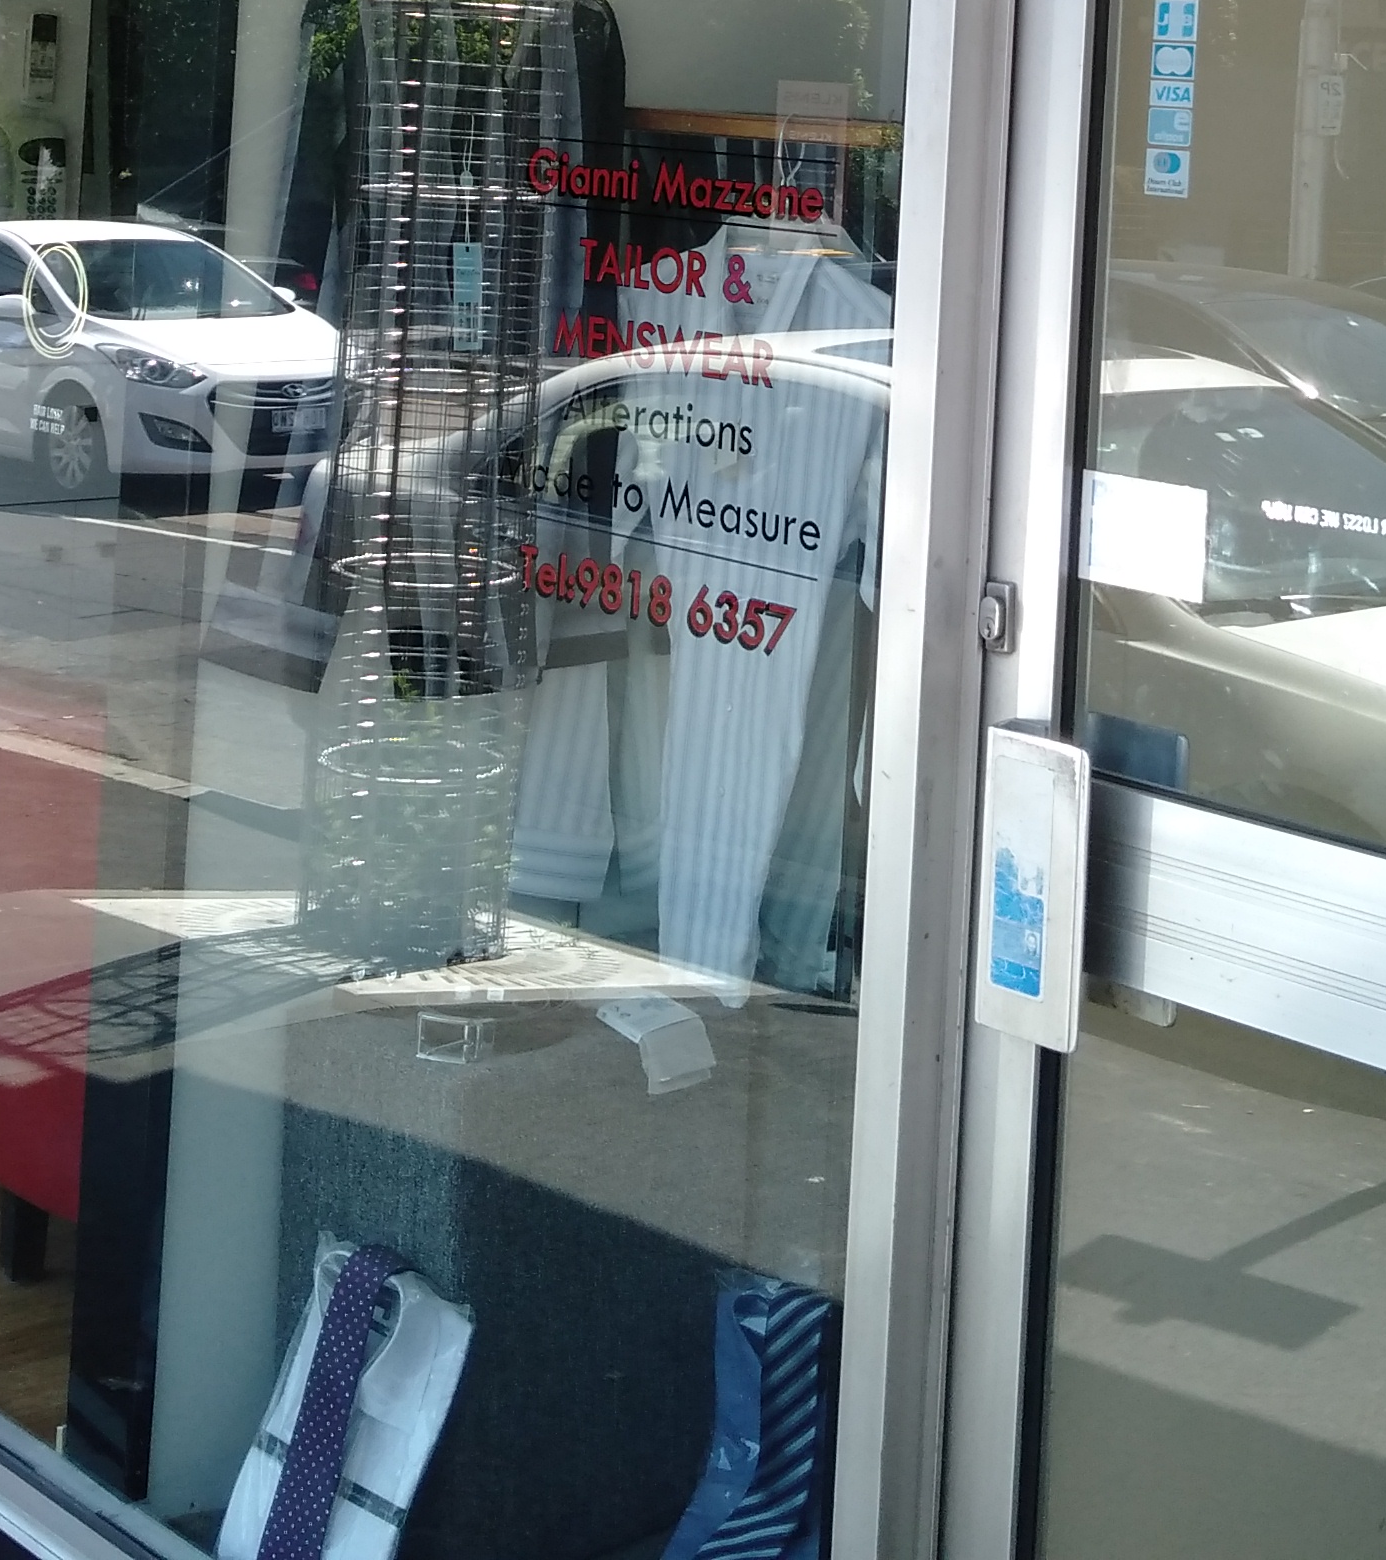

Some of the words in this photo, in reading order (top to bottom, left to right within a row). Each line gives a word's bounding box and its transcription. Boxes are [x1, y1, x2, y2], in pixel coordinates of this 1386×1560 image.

[1156, 85, 1191, 102] VISA
[528, 147, 639, 202] Gianni
[654, 157, 825, 224] Mazzone
[580, 238, 706, 298] TAILOR
[722, 254, 755, 305] &
[553, 308, 775, 389] MENSWEAR
[564, 382, 753, 455] Alterations
[611, 471, 644, 512] to
[659, 480, 822, 551] Measure
[518, 544, 673, 628] Tel:9818
[687, 584, 798, 657] 6357
